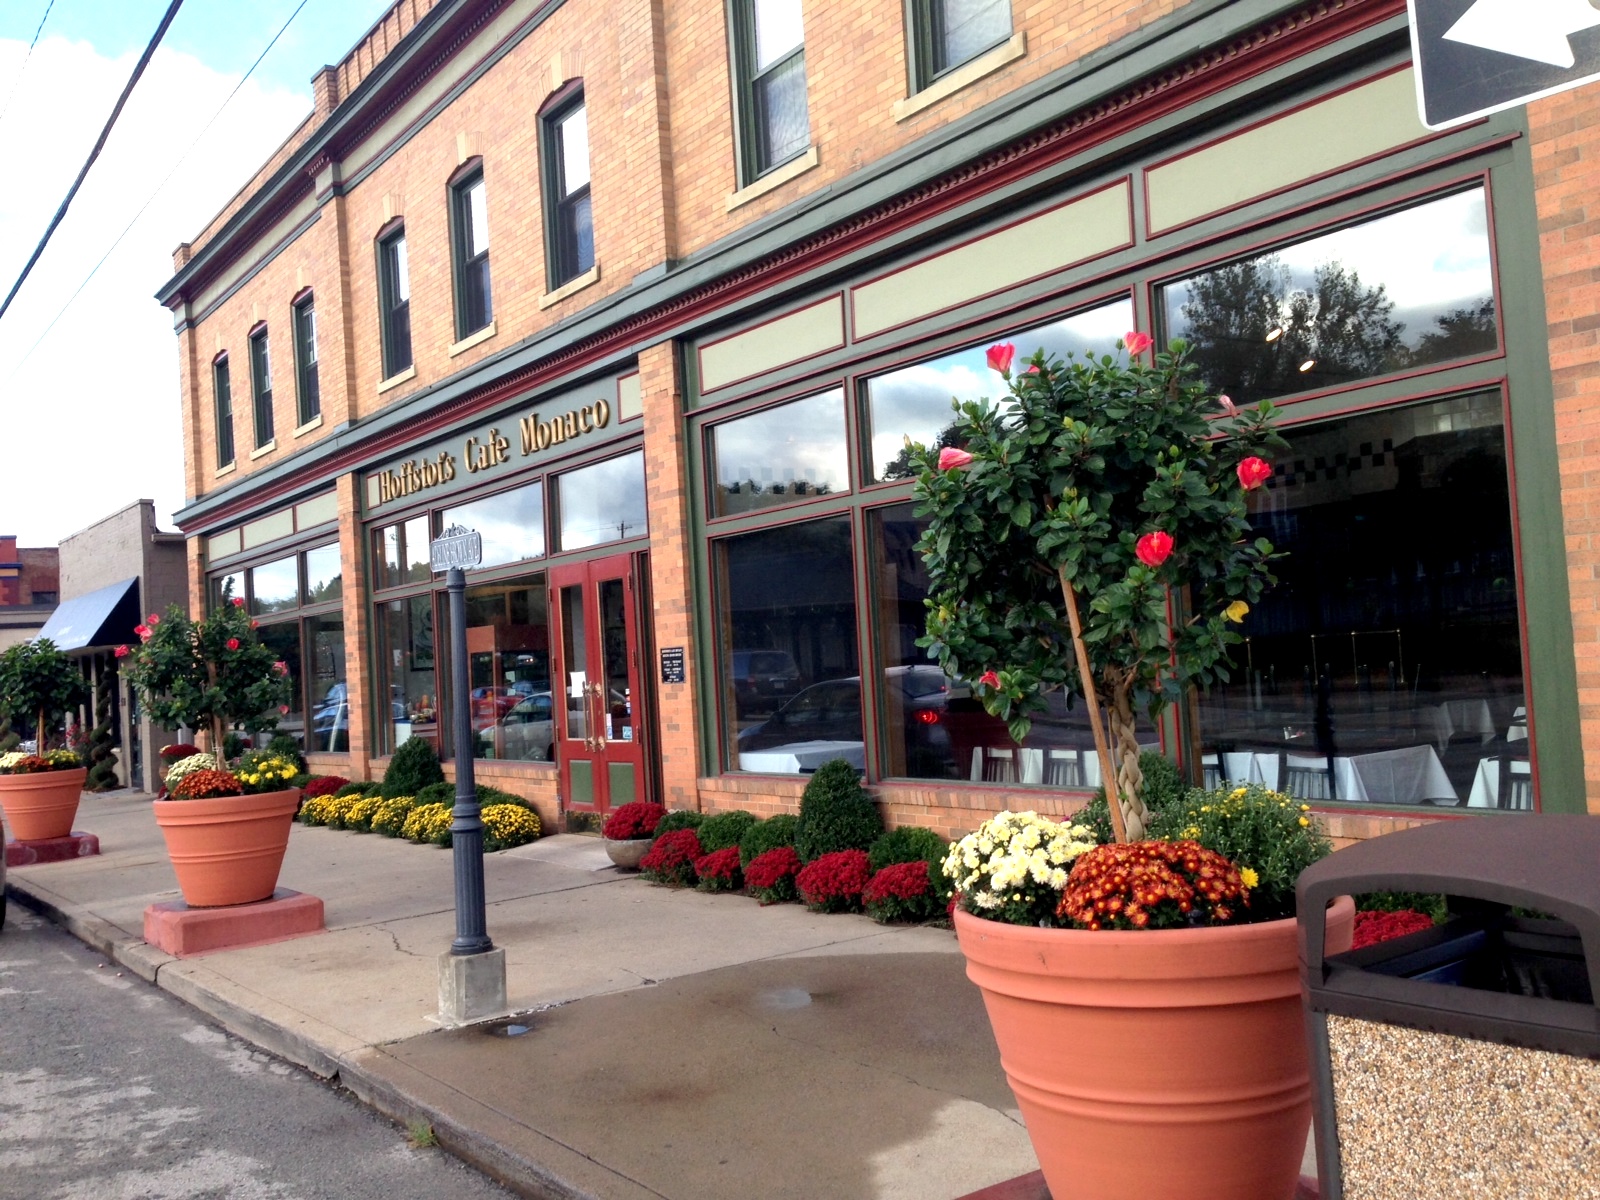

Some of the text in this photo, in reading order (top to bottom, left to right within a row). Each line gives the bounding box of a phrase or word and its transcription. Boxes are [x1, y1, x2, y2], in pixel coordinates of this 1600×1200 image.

[380, 398, 610, 503] Hoffstot's Cafe Monaco
